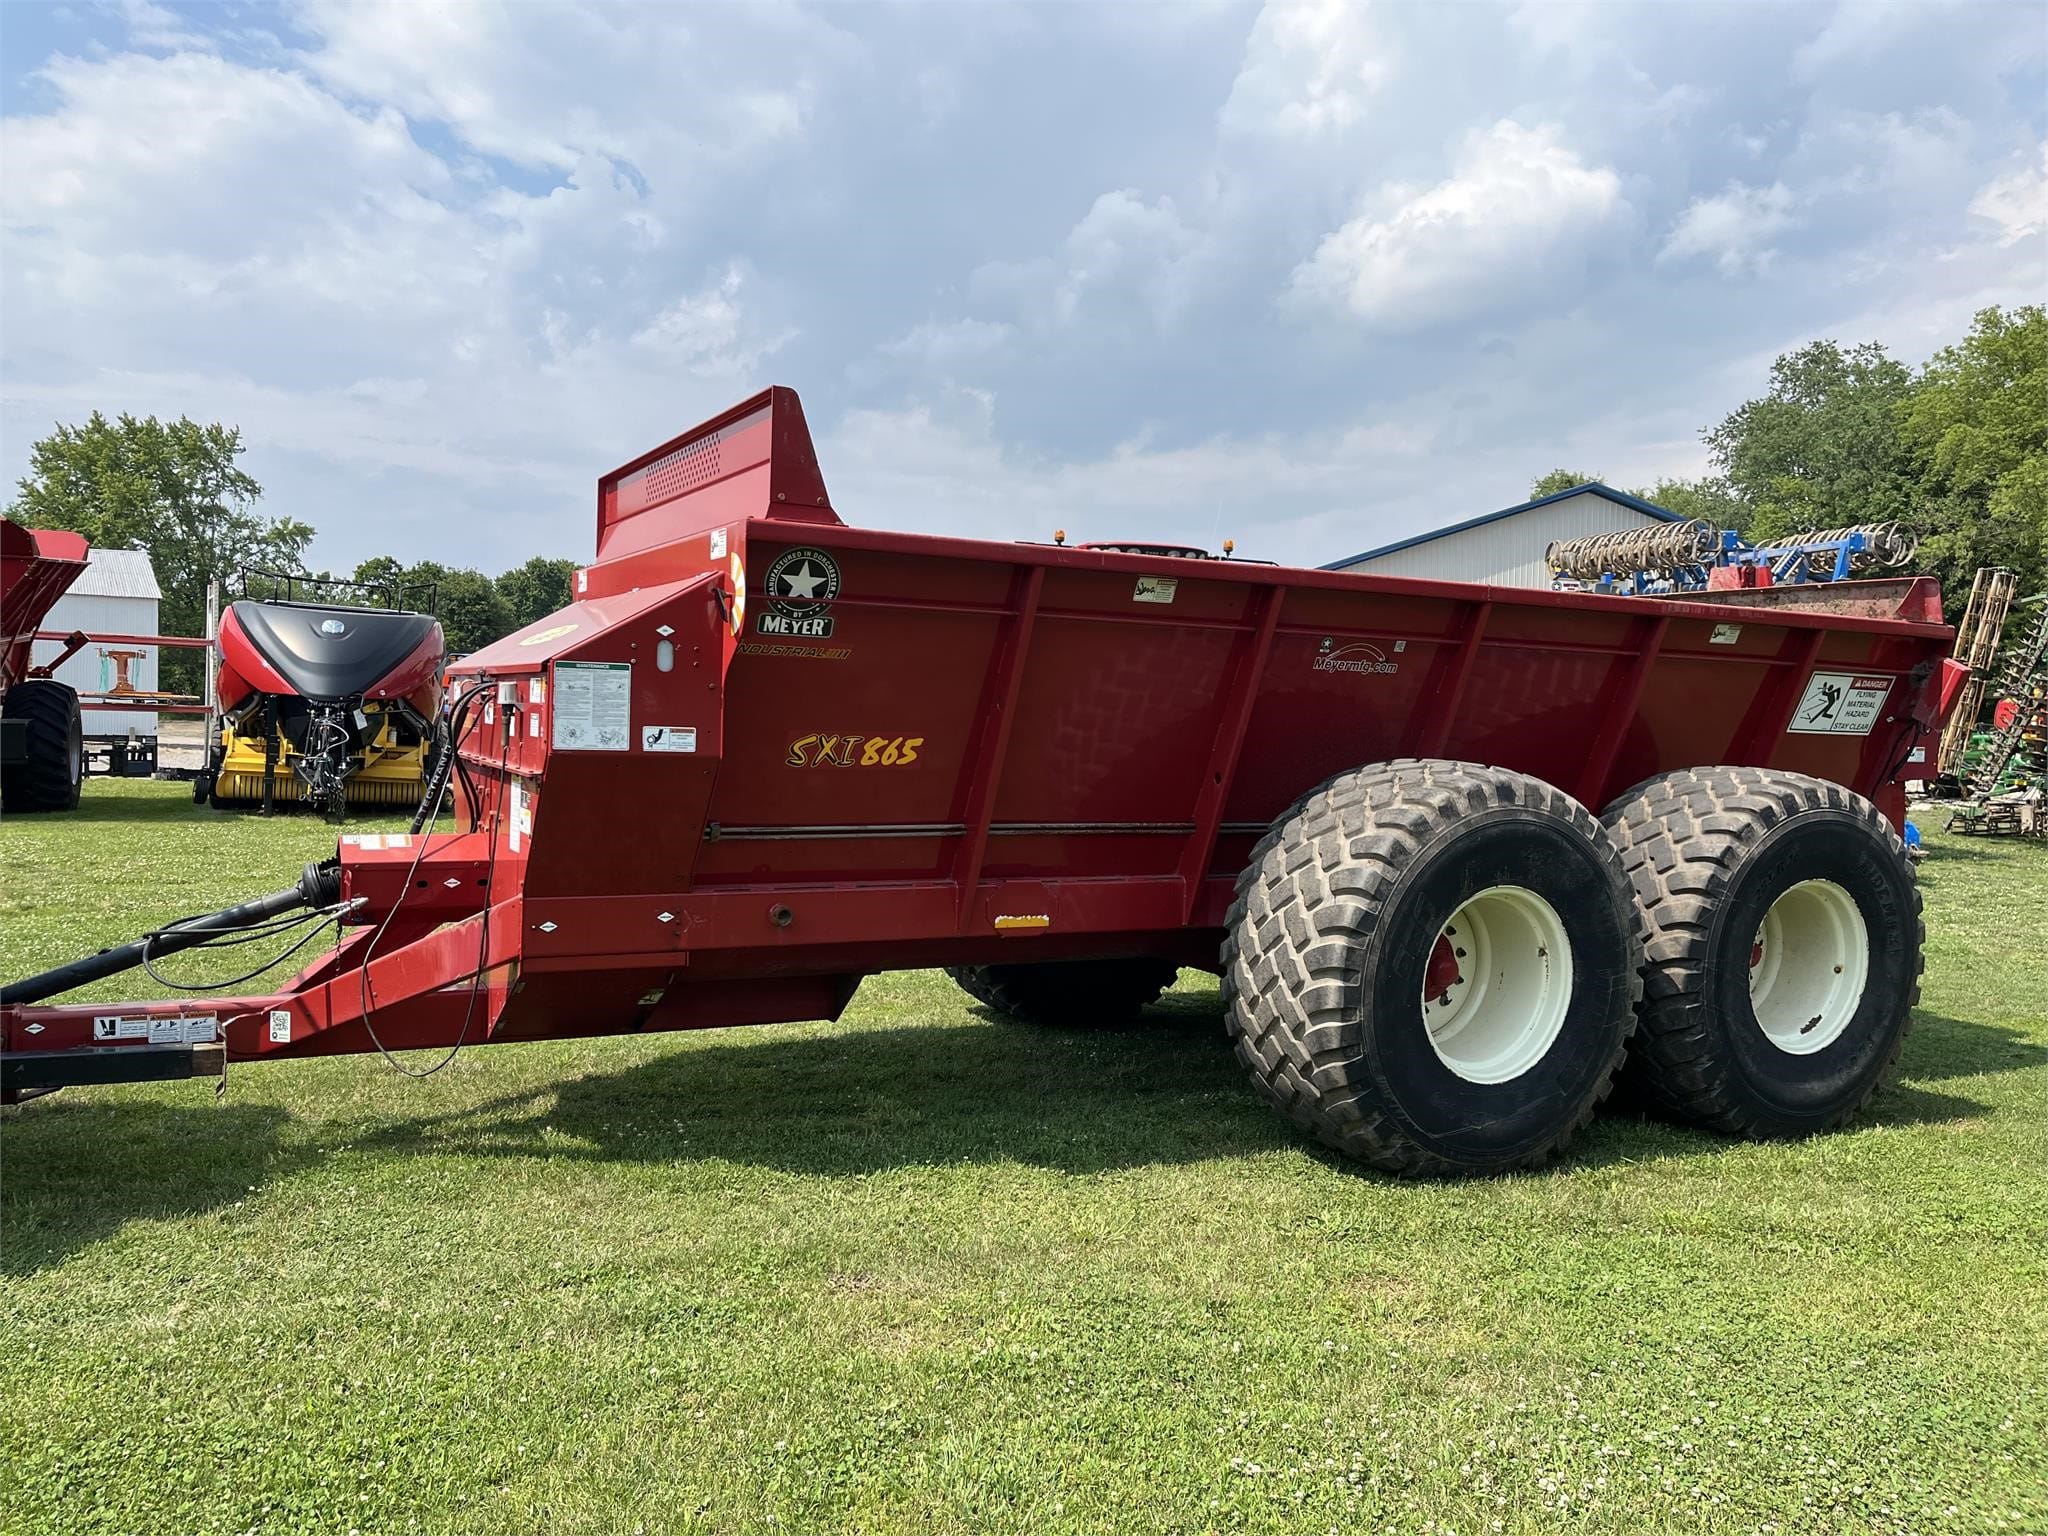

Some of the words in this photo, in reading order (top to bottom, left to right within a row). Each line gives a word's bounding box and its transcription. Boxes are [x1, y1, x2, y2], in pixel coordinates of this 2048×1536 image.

[813, 552, 837, 591] DORCHESTER
[763, 615, 825, 635] MEYER
[737, 640, 825, 658] NDUSTRIAL
[1313, 657, 1398, 675] Meyermfg.com
[1861, 680, 1888, 689] DANGER
[1855, 691, 1877, 699] FLYING
[1847, 700, 1876, 709] MATERIAL
[1833, 722, 1849, 730] STAY
[785, 733, 864, 768] SXI
[860, 736, 924, 766] 865
[421, 757, 448, 813] TECTRAN
